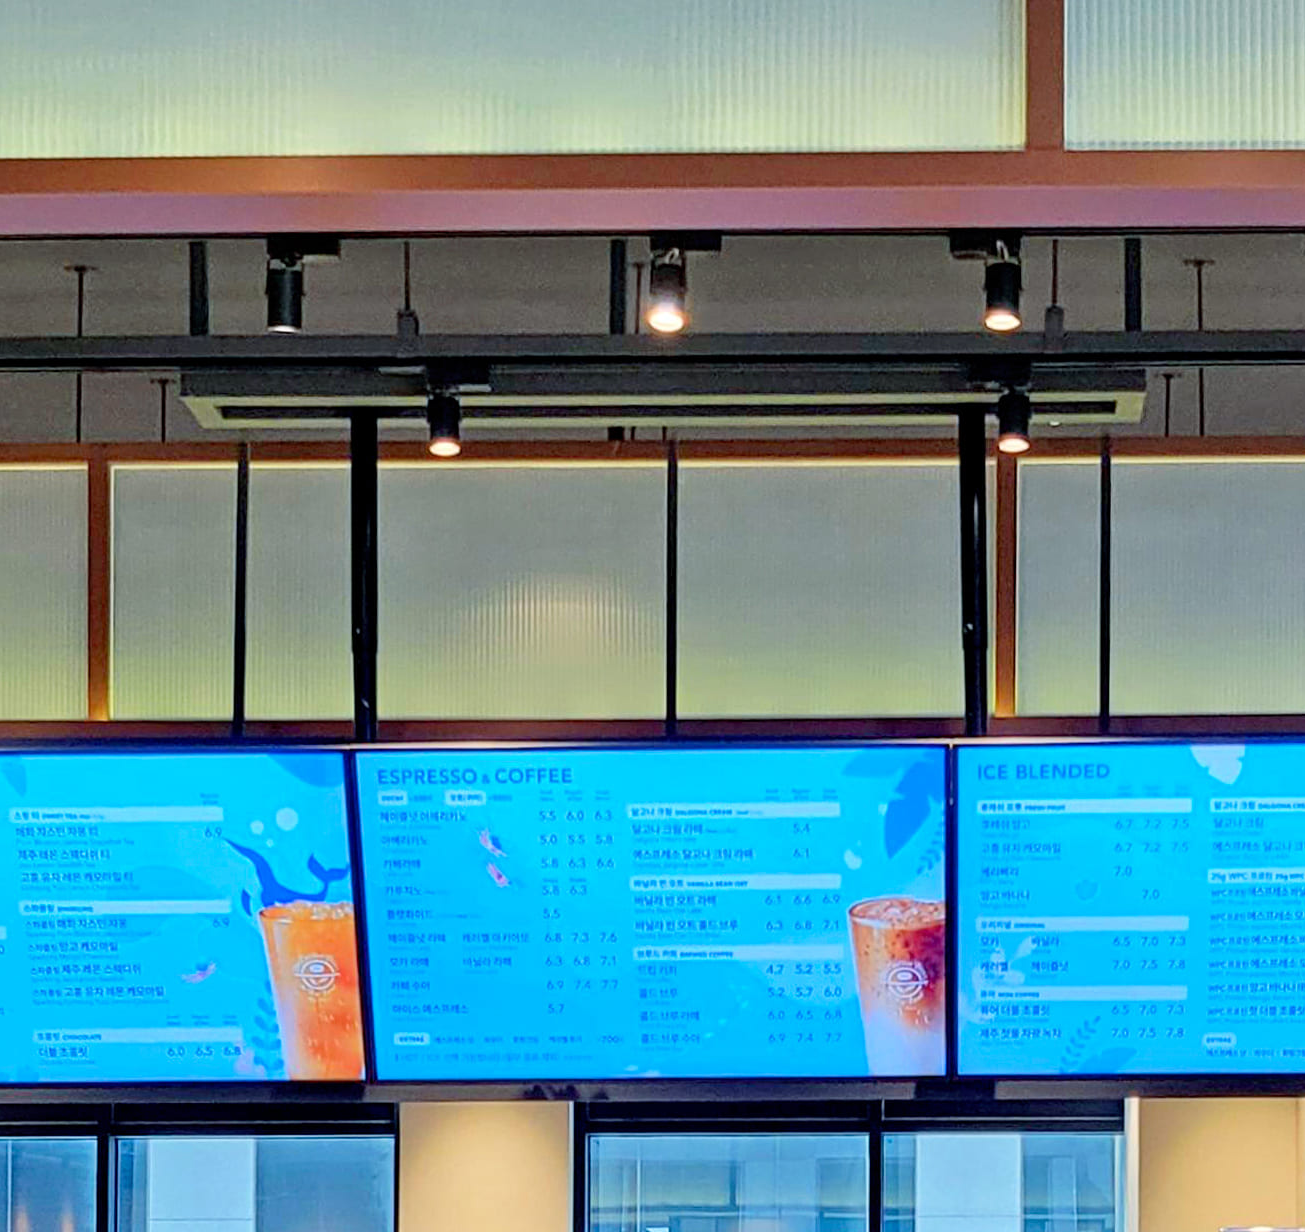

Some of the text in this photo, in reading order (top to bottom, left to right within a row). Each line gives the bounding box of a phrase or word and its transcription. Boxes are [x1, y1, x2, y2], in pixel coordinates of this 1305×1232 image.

[377, 767, 573, 784] ESPRESSO & COFFEE
[977, 763, 1111, 780] ICE BLENDED
[539, 810, 613, 822] 5.5 6.0 6.3
[204, 826, 223, 839] 6.9
[540, 834, 614, 846] 5.0 5.5 5.8
[764, 919, 840, 931] 6.3 6.8 7.1
[544, 932, 618, 944] 6.8 7.3 7.6
[544, 956, 618, 968] 6.3 6.8 7.1
[1111, 960, 1187, 972] 7.0 7.5 7.8
[766, 963, 842, 975] 4.7 5.2 5.5
[1110, 1028, 1185, 1040] 7.0 7.5 7.8
[167, 1046, 243, 1058] 6.0 6.5 6.8
